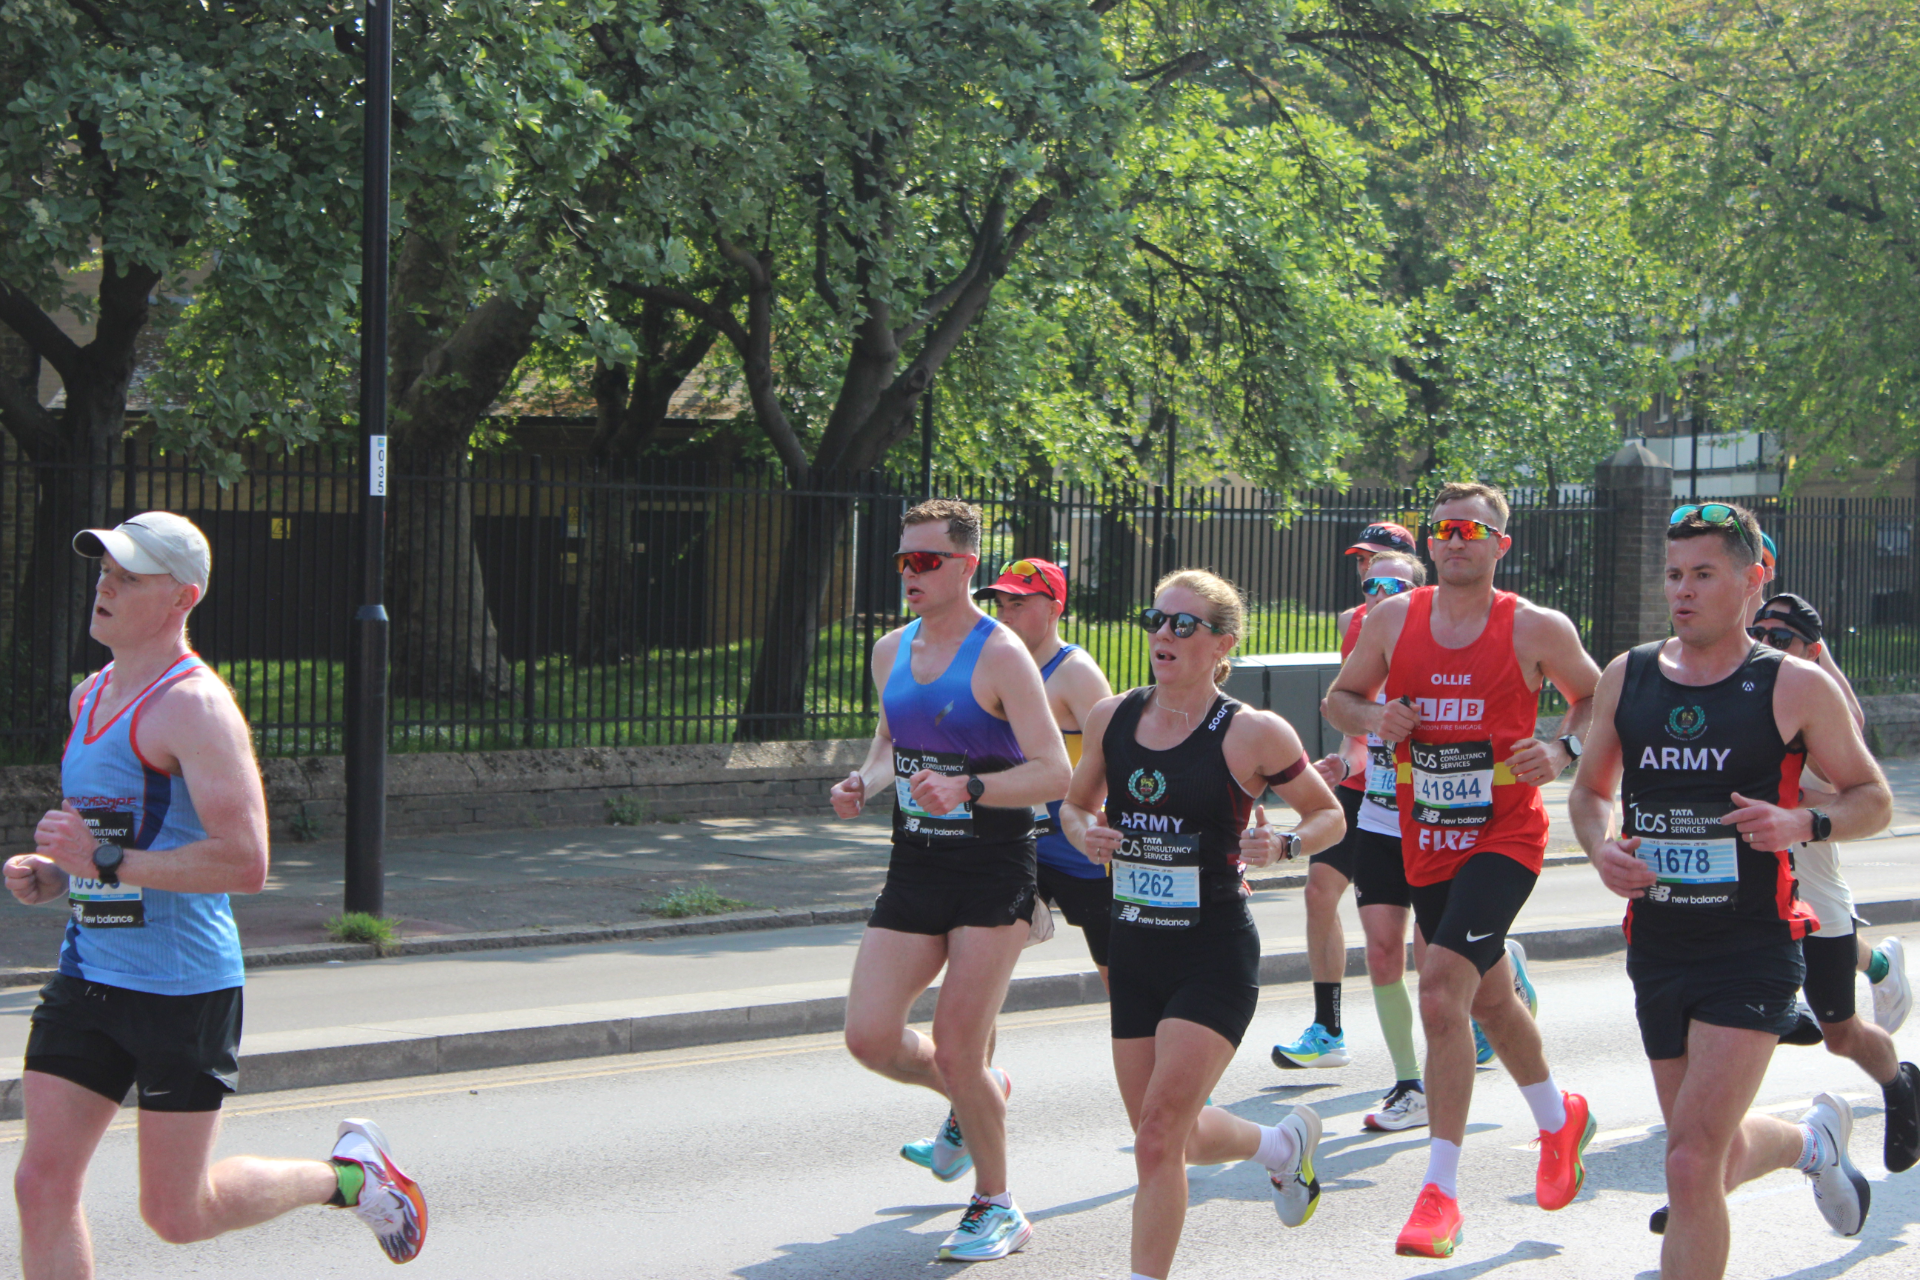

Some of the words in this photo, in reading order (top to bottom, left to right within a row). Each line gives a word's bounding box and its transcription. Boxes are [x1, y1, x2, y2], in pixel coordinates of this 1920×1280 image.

[377, 449, 385, 494] 035
[1431, 673, 1472, 685] OLLIE
[1208, 705, 1228, 731] soar
[922, 755, 938, 763] TATA
[1412, 745, 1437, 769] tcs
[1440, 752, 1487, 763] CONSULTANCY
[1639, 746, 1731, 771] ARMY
[896, 751, 919, 775] tcs
[922, 763, 964, 772] CONSULTANCY
[1440, 761, 1471, 769] SERVICES
[1422, 777, 1481, 801] 41844
[1121, 812, 1184, 834] ARMY
[1457, 816, 1487, 825] balance
[1635, 806, 1667, 833] tcs
[1670, 817, 1722, 825] CONSULTANC
[90, 829, 128, 837] NSULTANCY
[934, 828, 965, 836] balance
[1670, 826, 1706, 834] SERVICES
[1142, 837, 1162, 845] TATA
[1419, 828, 1479, 851] FIRE
[1115, 837, 1141, 858] cs
[1143, 845, 1192, 854] CONSULTANCY
[1143, 853, 1173, 861] SERVICES
[1653, 847, 1710, 874] 1678
[1128, 870, 1174, 898] 1262
[1671, 896, 1688, 904] new
[1690, 895, 1729, 904] balance
[84, 916, 95, 924] new
[96, 915, 134, 924] balance
[1138, 916, 1154, 925] new
[1155, 917, 1190, 927] balance
